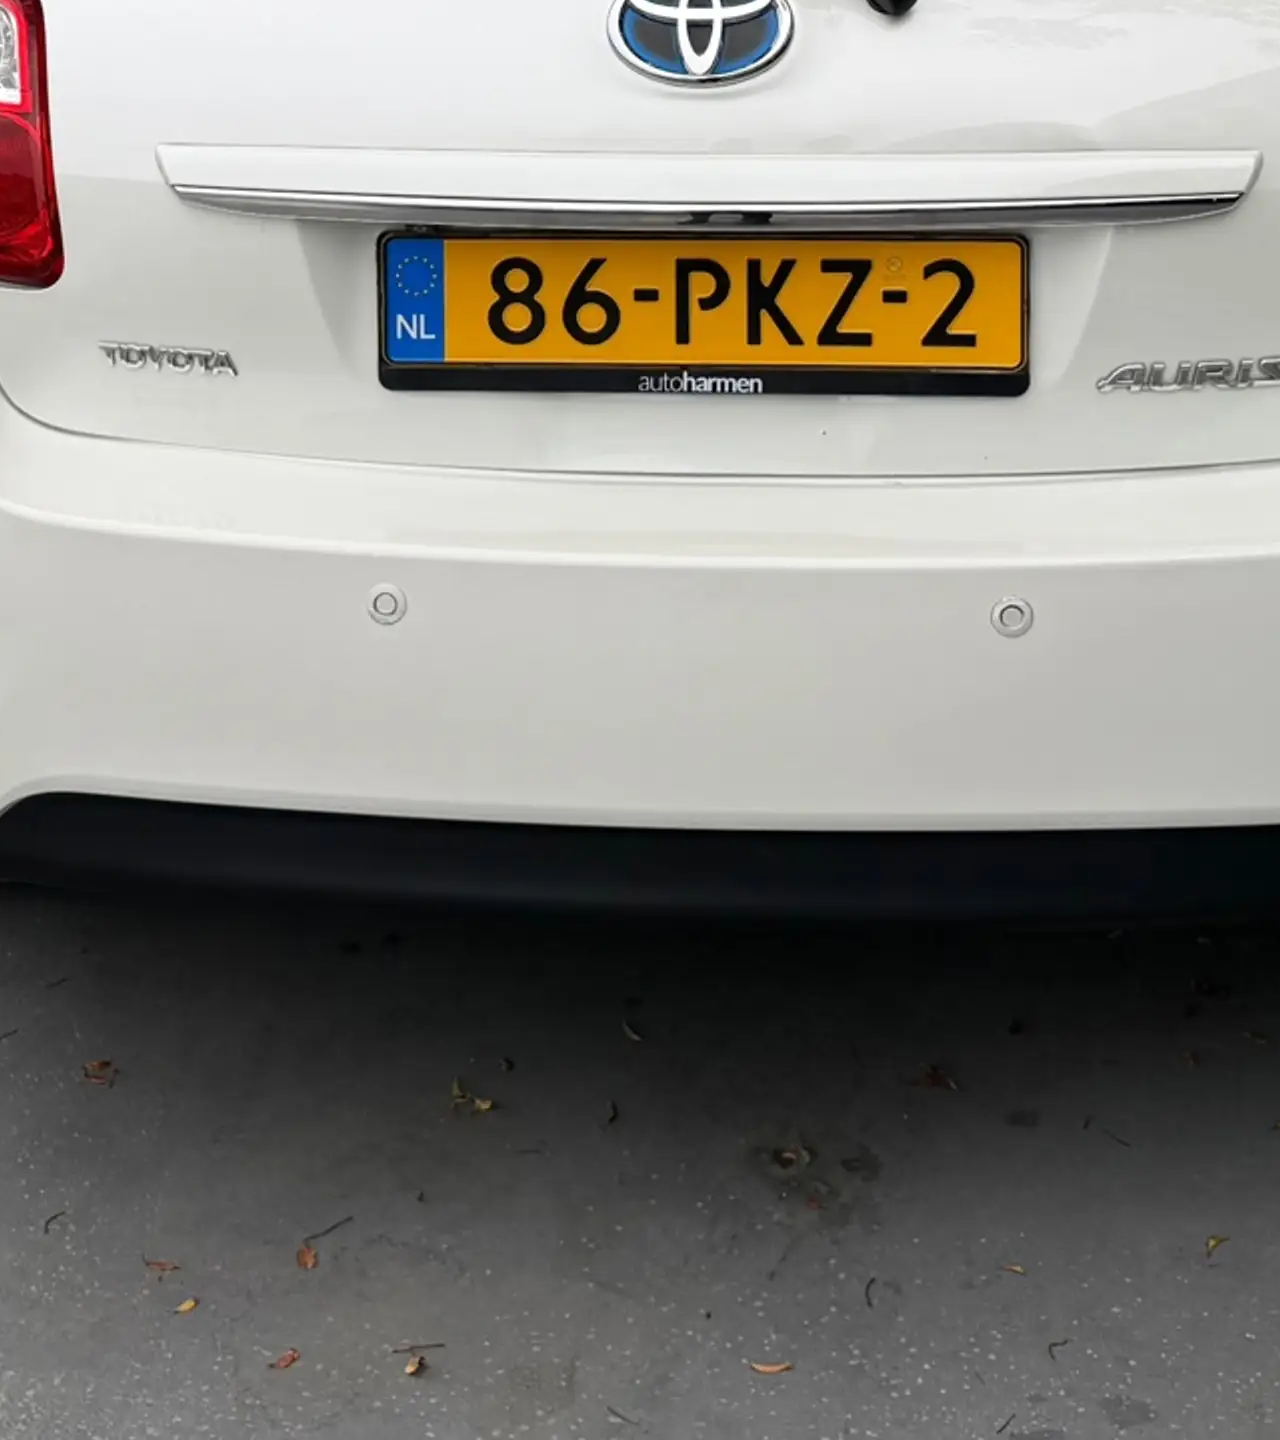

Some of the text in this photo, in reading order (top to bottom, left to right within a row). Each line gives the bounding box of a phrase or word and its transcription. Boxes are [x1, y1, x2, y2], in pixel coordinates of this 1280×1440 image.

[487, 256, 978, 348] 86-PKZ-2
[395, 314, 435, 340] NL
[98, 339, 239, 377] TOYOTA
[638, 369, 763, 393] autoharmen
